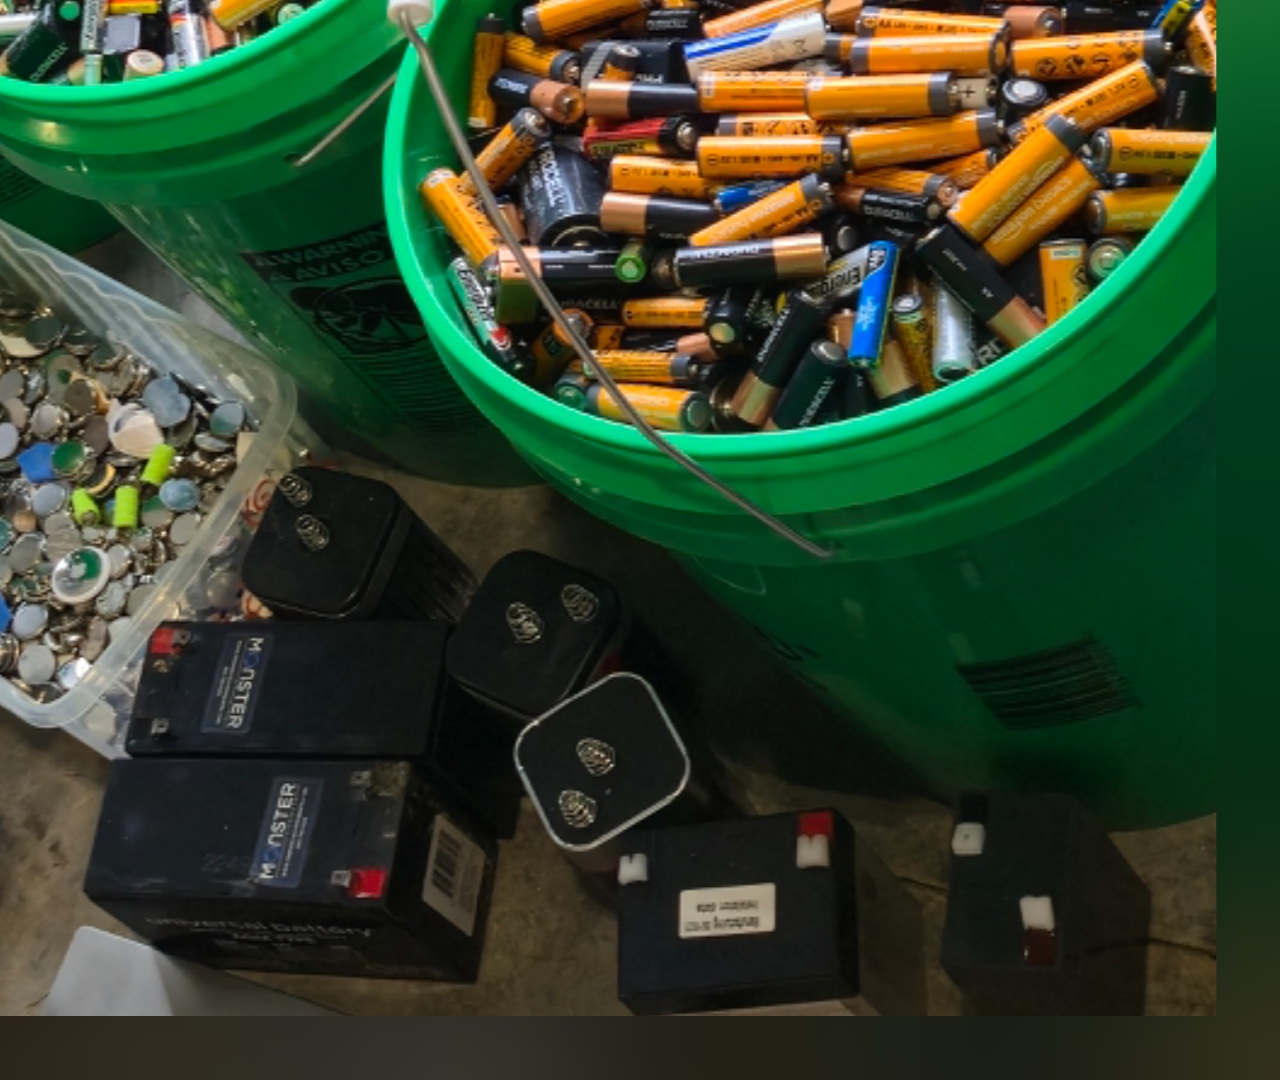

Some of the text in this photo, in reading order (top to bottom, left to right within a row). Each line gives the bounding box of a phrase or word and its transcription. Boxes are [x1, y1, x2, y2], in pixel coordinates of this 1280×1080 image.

[29, 42, 69, 82] DURACELL
[226, 637, 265, 729] MONSTER
[258, 782, 297, 880] MONSTER
